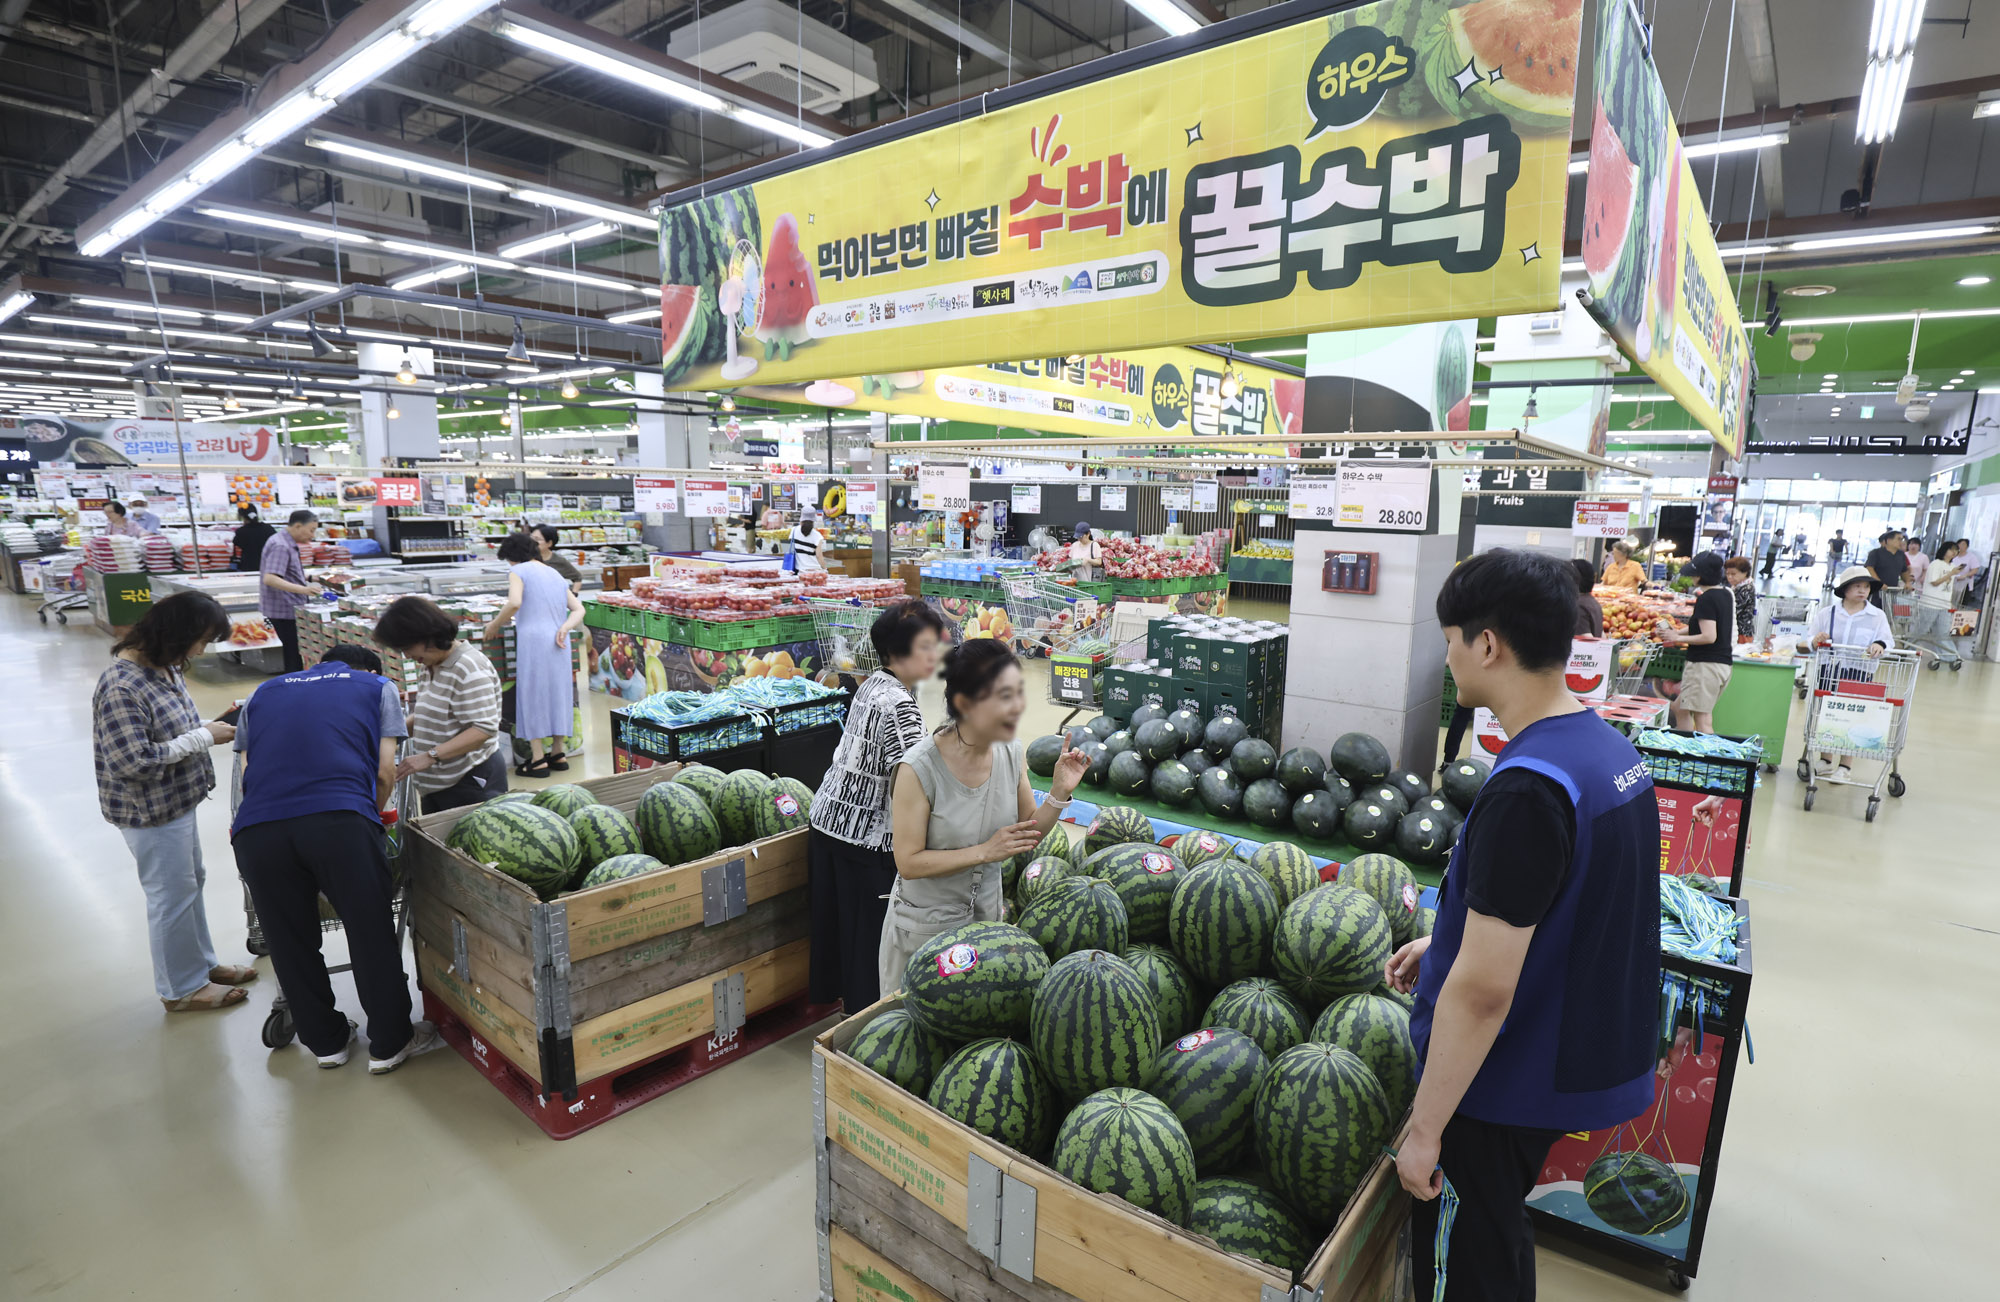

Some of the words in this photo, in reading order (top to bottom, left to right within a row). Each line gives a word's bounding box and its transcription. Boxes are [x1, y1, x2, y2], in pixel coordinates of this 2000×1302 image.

[1316, 43, 1410, 100] 하우스
[816, 218, 928, 283] 먹어보면
[933, 204, 1001, 261] 빠질
[1007, 151, 1169, 251] 수박에
[1189, 132, 1500, 290] 꿀수박
[981, 286, 1010, 305] 햇사레
[1089, 354, 1145, 397] 수박에
[1153, 380, 1190, 410] 하우스
[124, 440, 193, 455] 잡곡밥으로
[195, 438, 225, 452] 건강
[1342, 472, 1365, 481] 하우스
[1366, 472, 1383, 481] 수박
[381, 483, 417, 501] 곶감
[943, 497, 967, 509] 28,800
[1266, 504, 1285, 512] 바나나
[1493, 495, 1524, 506] Fruits
[1316, 506, 1334, 517] 32,8
[1378, 509, 1423, 525] 28,800
[120, 588, 152, 603] 국산
[1569, 660, 1599, 668] 신선하다!
[1573, 653, 1593, 661] 맛있게
[1053, 664, 1089, 679] 매장작업
[1063, 677, 1081, 689] 전용
[1826, 700, 1846, 711] 강화
[1846, 702, 1866, 713] 섬쌀
[1486, 721, 1503, 729] 신선
[1613, 761, 1650, 793] 하나로마트
[471, 1036, 488, 1057] KPP
[707, 1028, 738, 1052] KPP
